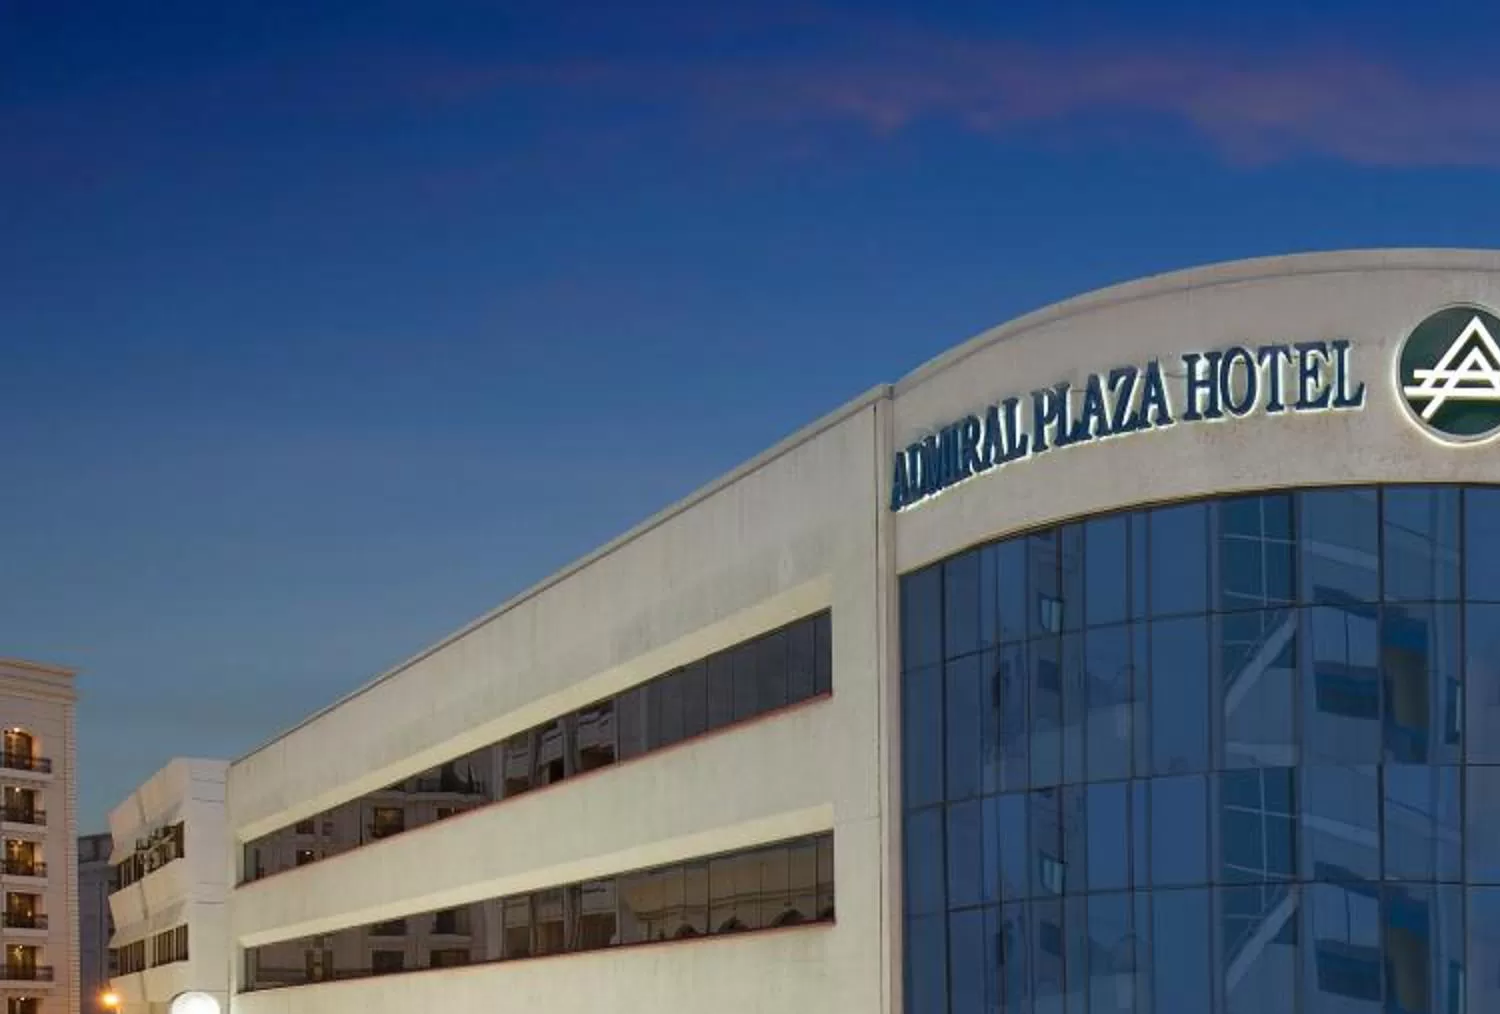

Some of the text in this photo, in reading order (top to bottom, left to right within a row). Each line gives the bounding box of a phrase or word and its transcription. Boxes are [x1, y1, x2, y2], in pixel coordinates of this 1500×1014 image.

[890, 339, 1366, 512] ADMIRAL PLAZA HOTEL
